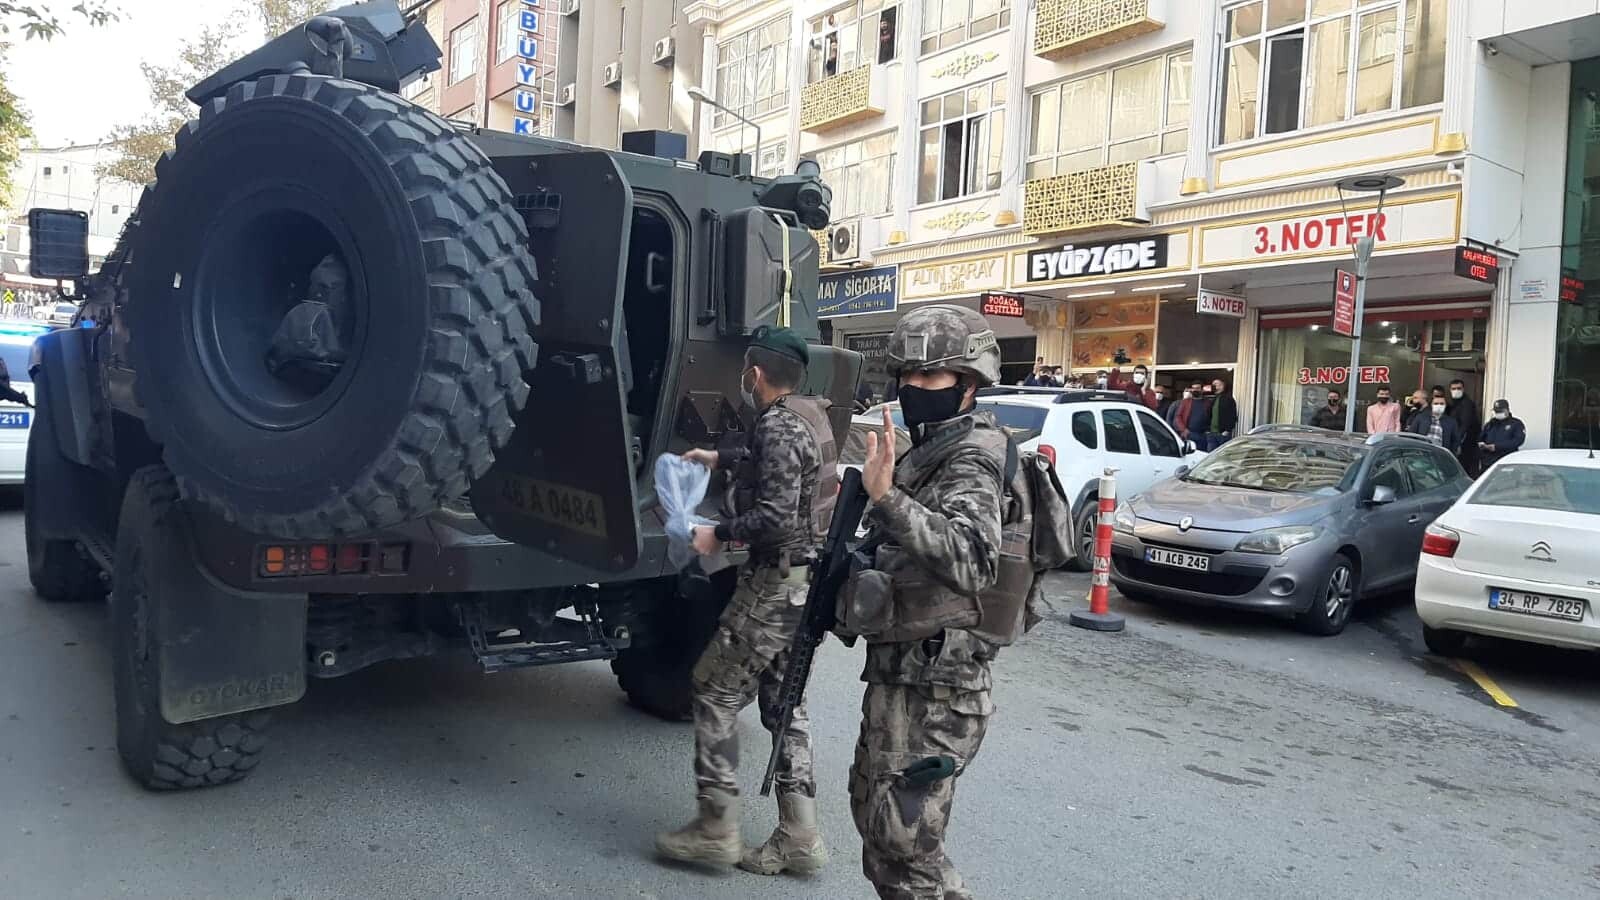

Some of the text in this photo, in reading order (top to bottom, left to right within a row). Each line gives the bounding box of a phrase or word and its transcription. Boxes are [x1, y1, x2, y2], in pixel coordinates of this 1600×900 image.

[1032, 241, 1156, 280] EYÜPZADE
[912, 259, 996, 287] ALTIN SARAY
[845, 275, 892, 297] SİGORTA
[1297, 365, 1390, 384] 3.NOER
[0, 414, 24, 425] 211
[548, 488, 598, 528] 0484
[1166, 552, 1184, 565] ACB
[1187, 556, 1208, 569] 245
[1499, 592, 1514, 606] 34
[1523, 595, 1540, 608] RP
[1547, 598, 1582, 615] 7825
